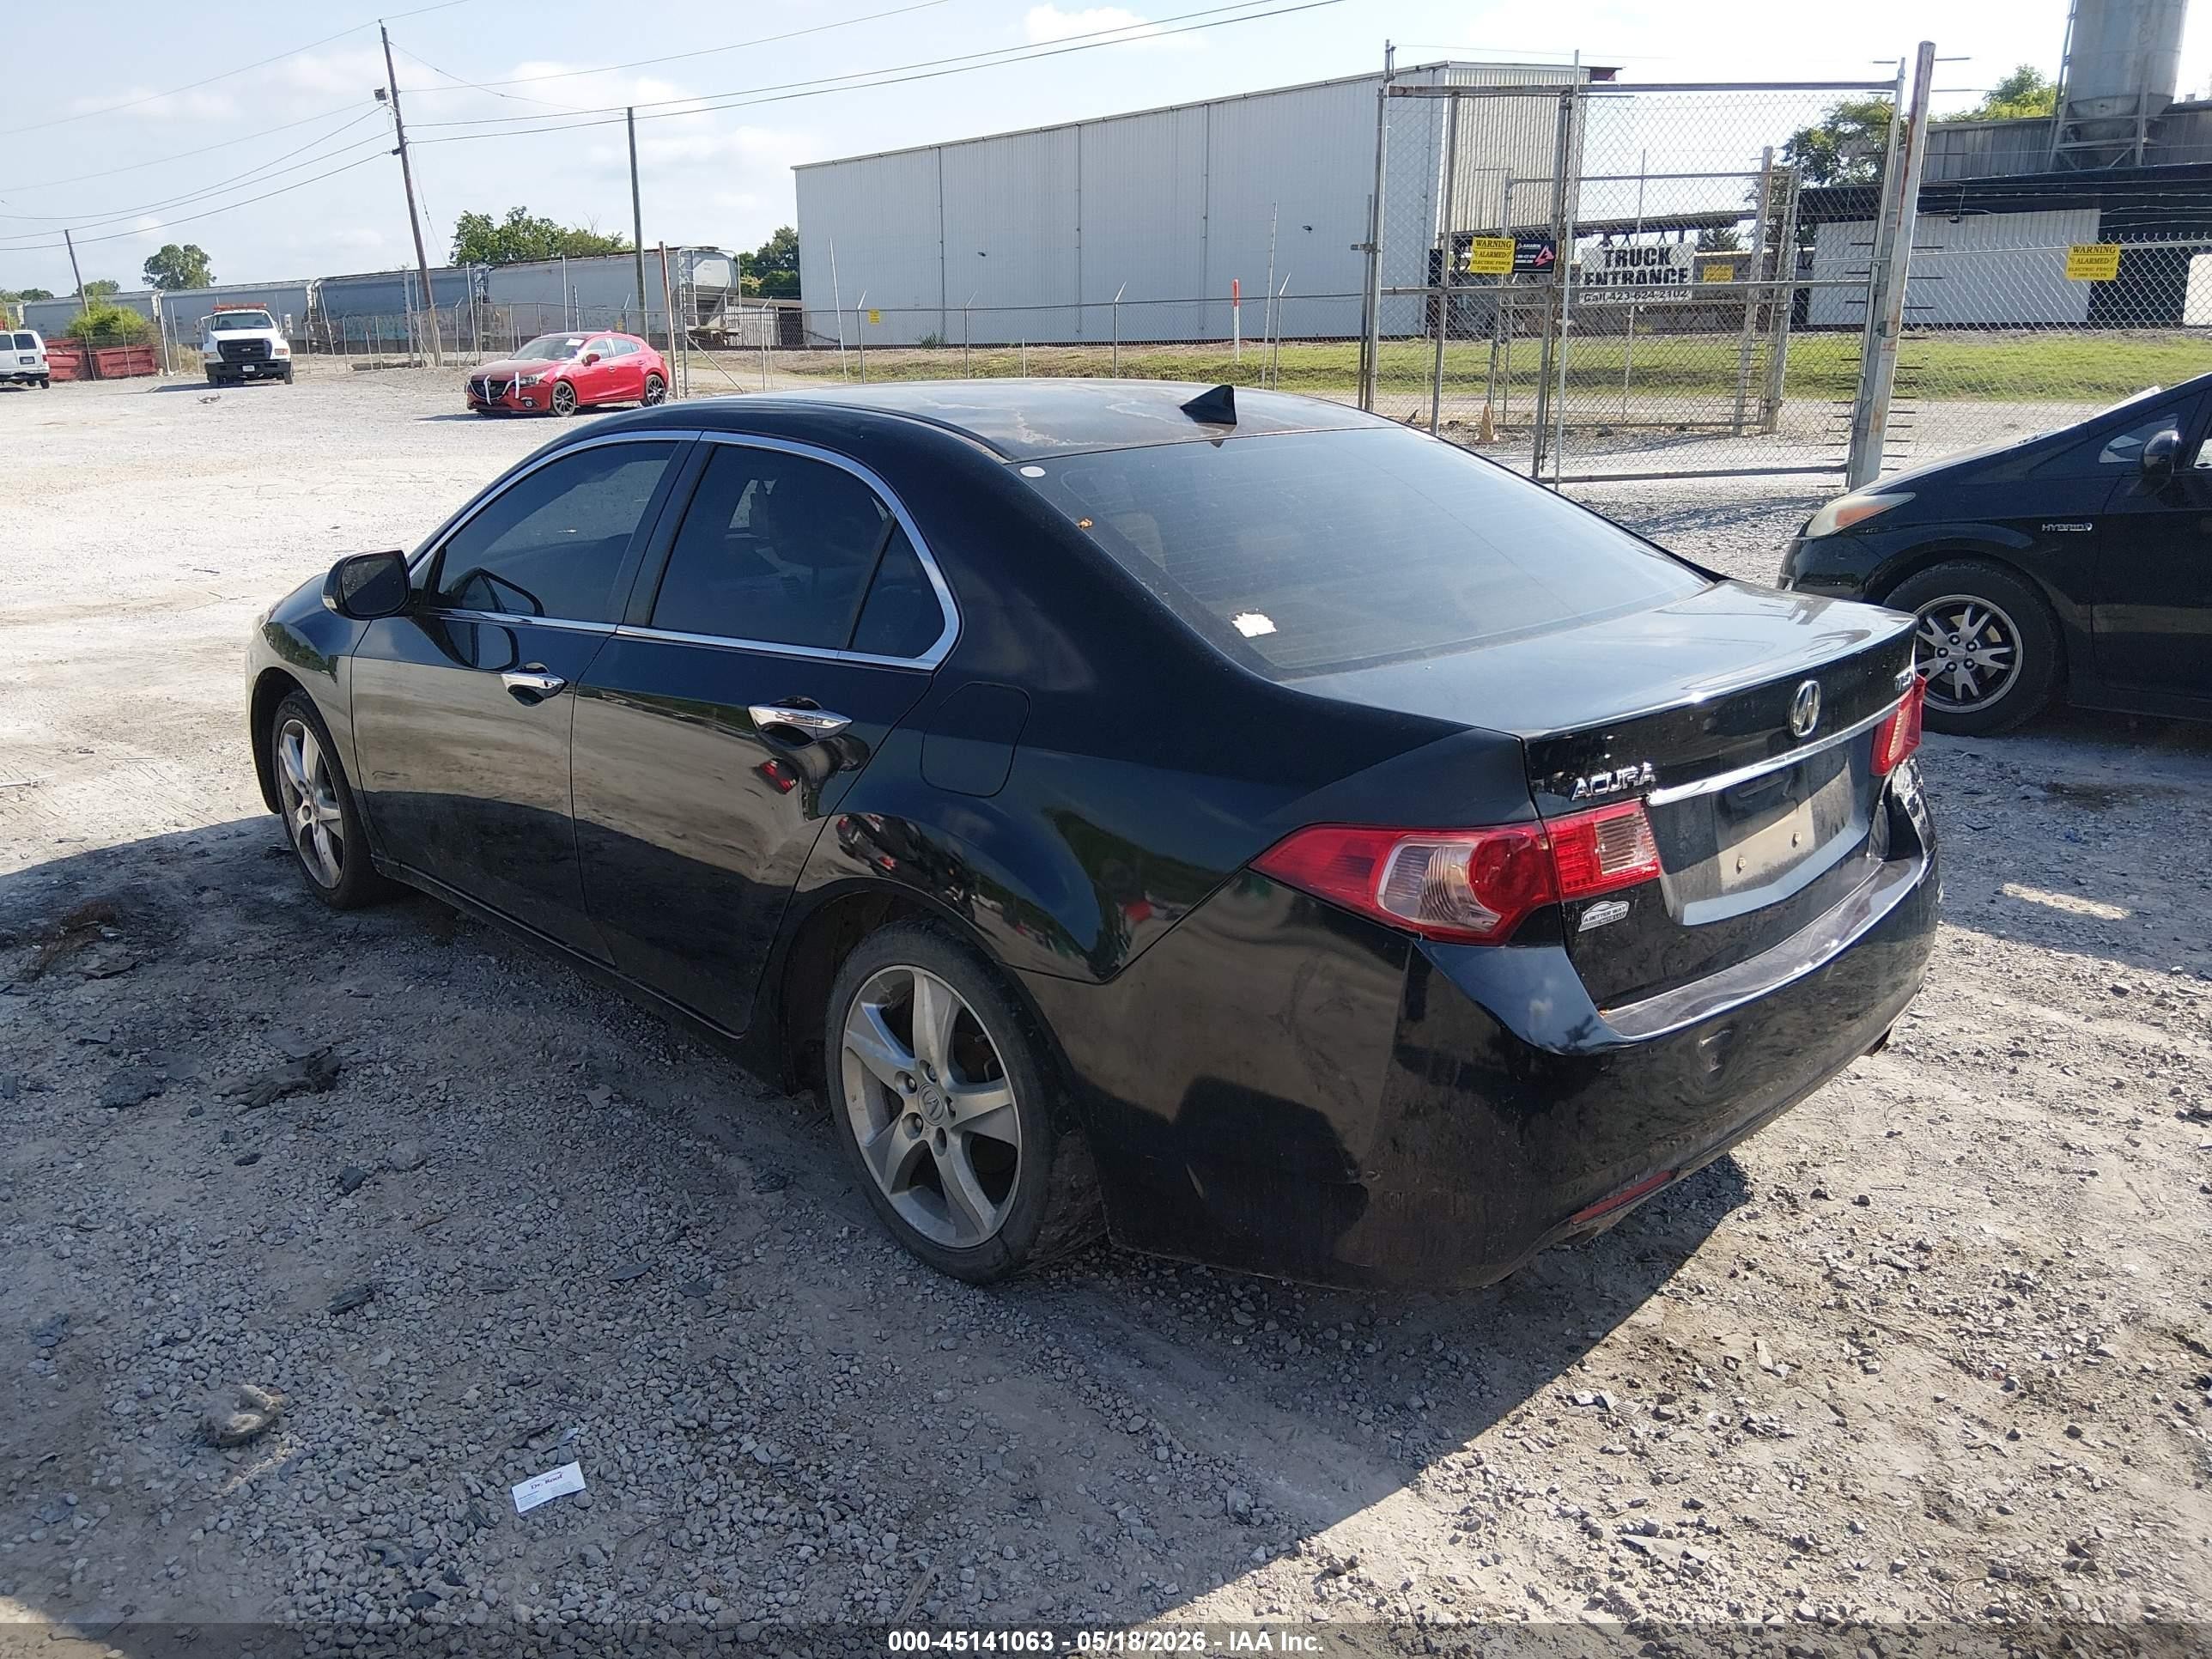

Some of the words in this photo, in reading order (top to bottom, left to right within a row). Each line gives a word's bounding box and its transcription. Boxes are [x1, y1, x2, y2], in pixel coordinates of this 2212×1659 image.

[1475, 240, 1511, 248] WARNING
[1604, 247, 1672, 268] TRUCK
[1584, 267, 1689, 286] ENTRANCE
[1584, 293, 1606, 302] Call
[1569, 762, 1657, 802] ACURA
